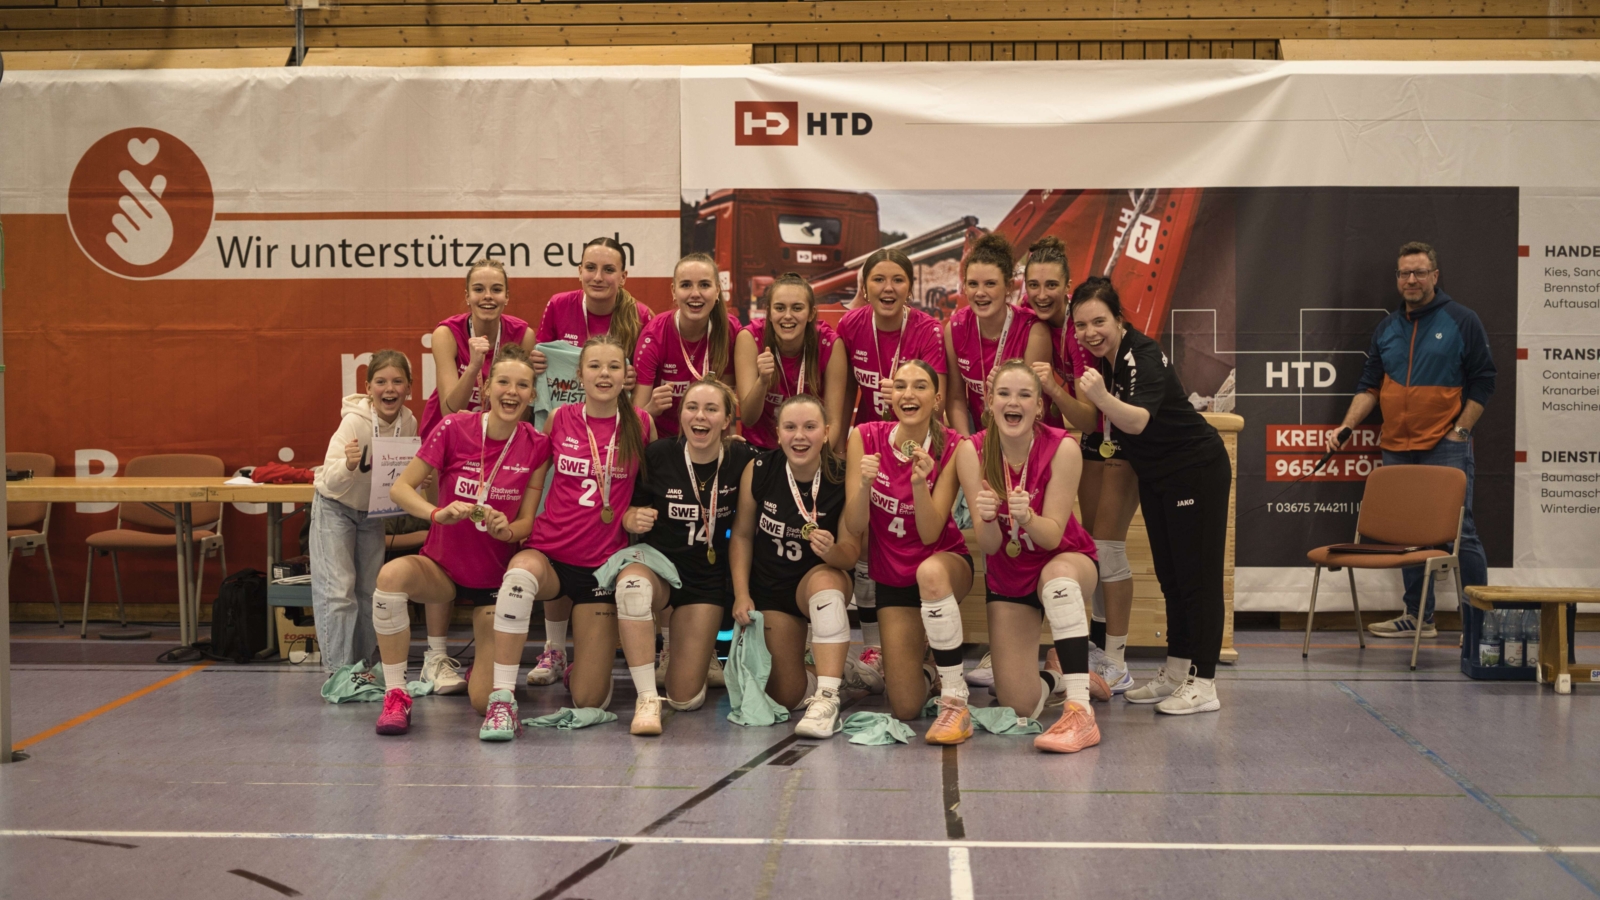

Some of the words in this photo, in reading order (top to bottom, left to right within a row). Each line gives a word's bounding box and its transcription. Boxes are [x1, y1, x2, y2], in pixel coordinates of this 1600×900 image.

[807, 112, 873, 136] HTD
[216, 236, 279, 268] Wir
[291, 234, 530, 268] unterstützen
[543, 232, 635, 267] euh
[1545, 245, 1600, 257] HANDE
[1544, 266, 1571, 278] Kies,
[855, 370, 876, 385] SWE
[1266, 361, 1337, 388] HTD
[1542, 385, 1600, 396] Kranarbei
[873, 391, 885, 416] 5
[1541, 401, 1600, 412] Maschine
[560, 458, 586, 475] SWE
[1275, 459, 1339, 476] 96524
[459, 481, 480, 496] SW
[491, 486, 519, 495] Stadtwerke
[578, 479, 598, 507] 2
[872, 492, 895, 511] SWE
[1177, 498, 1194, 507] JAKO
[1266, 502, 1273, 513] T
[1276, 502, 1310, 513] 03675
[1313, 502, 1347, 513] 744211
[671, 506, 696, 518] SWE
[685, 521, 709, 546] 14
[760, 518, 782, 535] SWE
[888, 517, 906, 538] 4
[772, 538, 802, 562] 13
